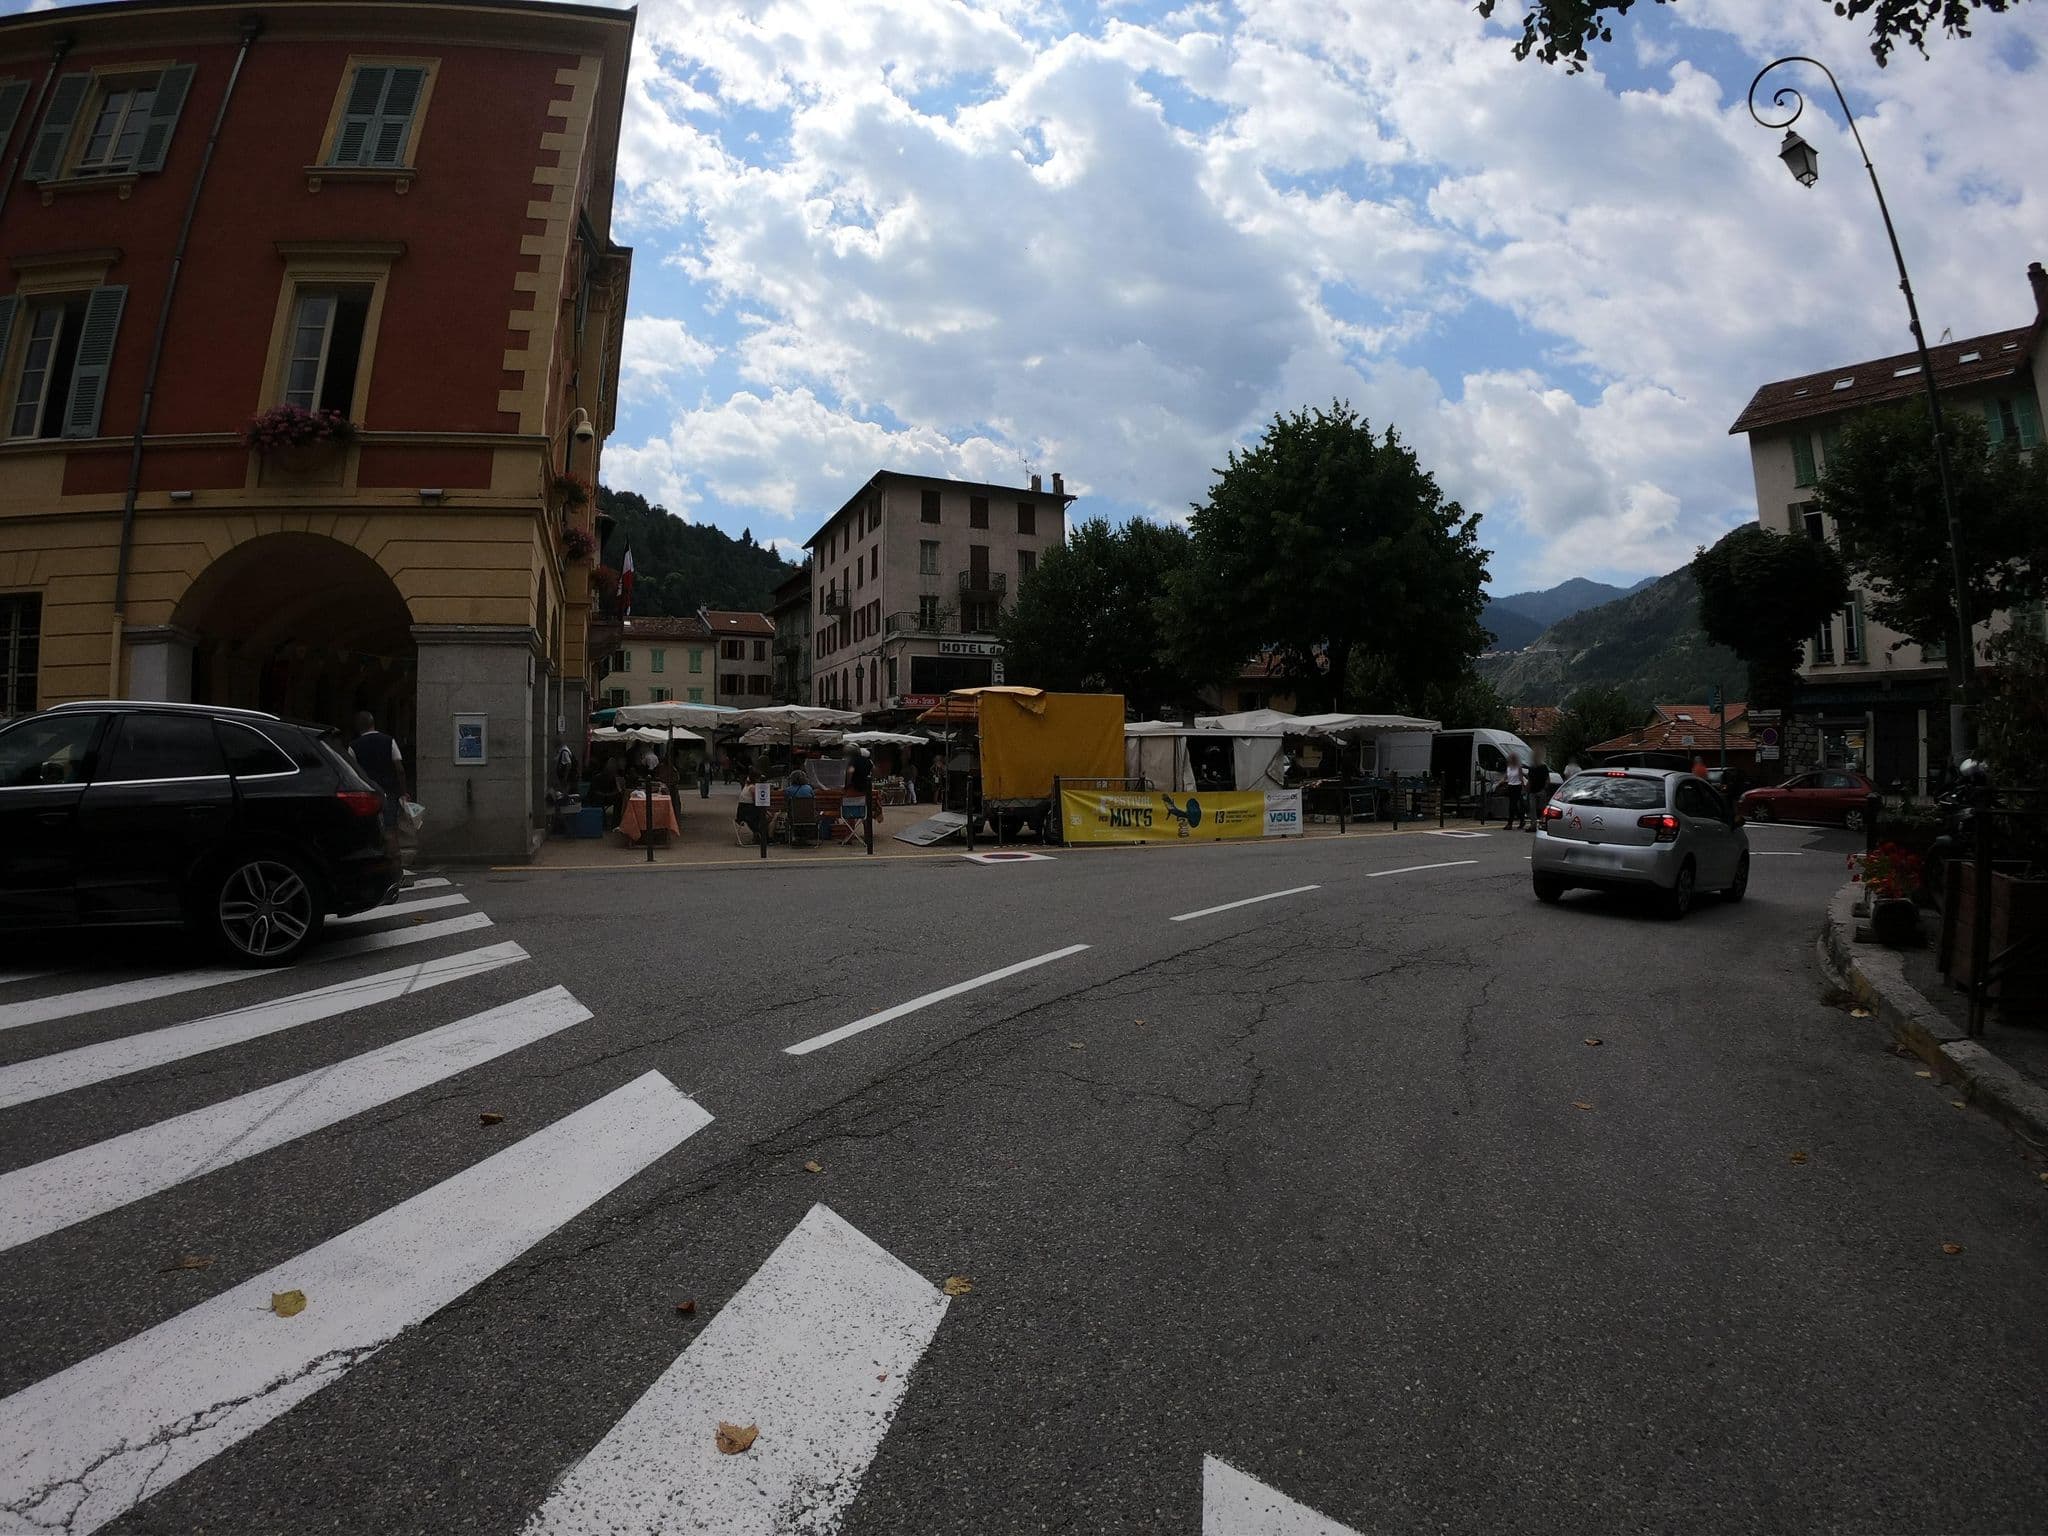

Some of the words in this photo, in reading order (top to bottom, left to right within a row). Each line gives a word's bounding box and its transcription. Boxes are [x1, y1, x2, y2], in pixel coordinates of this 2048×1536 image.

[942, 642, 985, 654] HOTEL
[1110, 808, 1153, 827] MOTS
[1214, 810, 1225, 824] 13
[1269, 812, 1297, 823] VOUS
